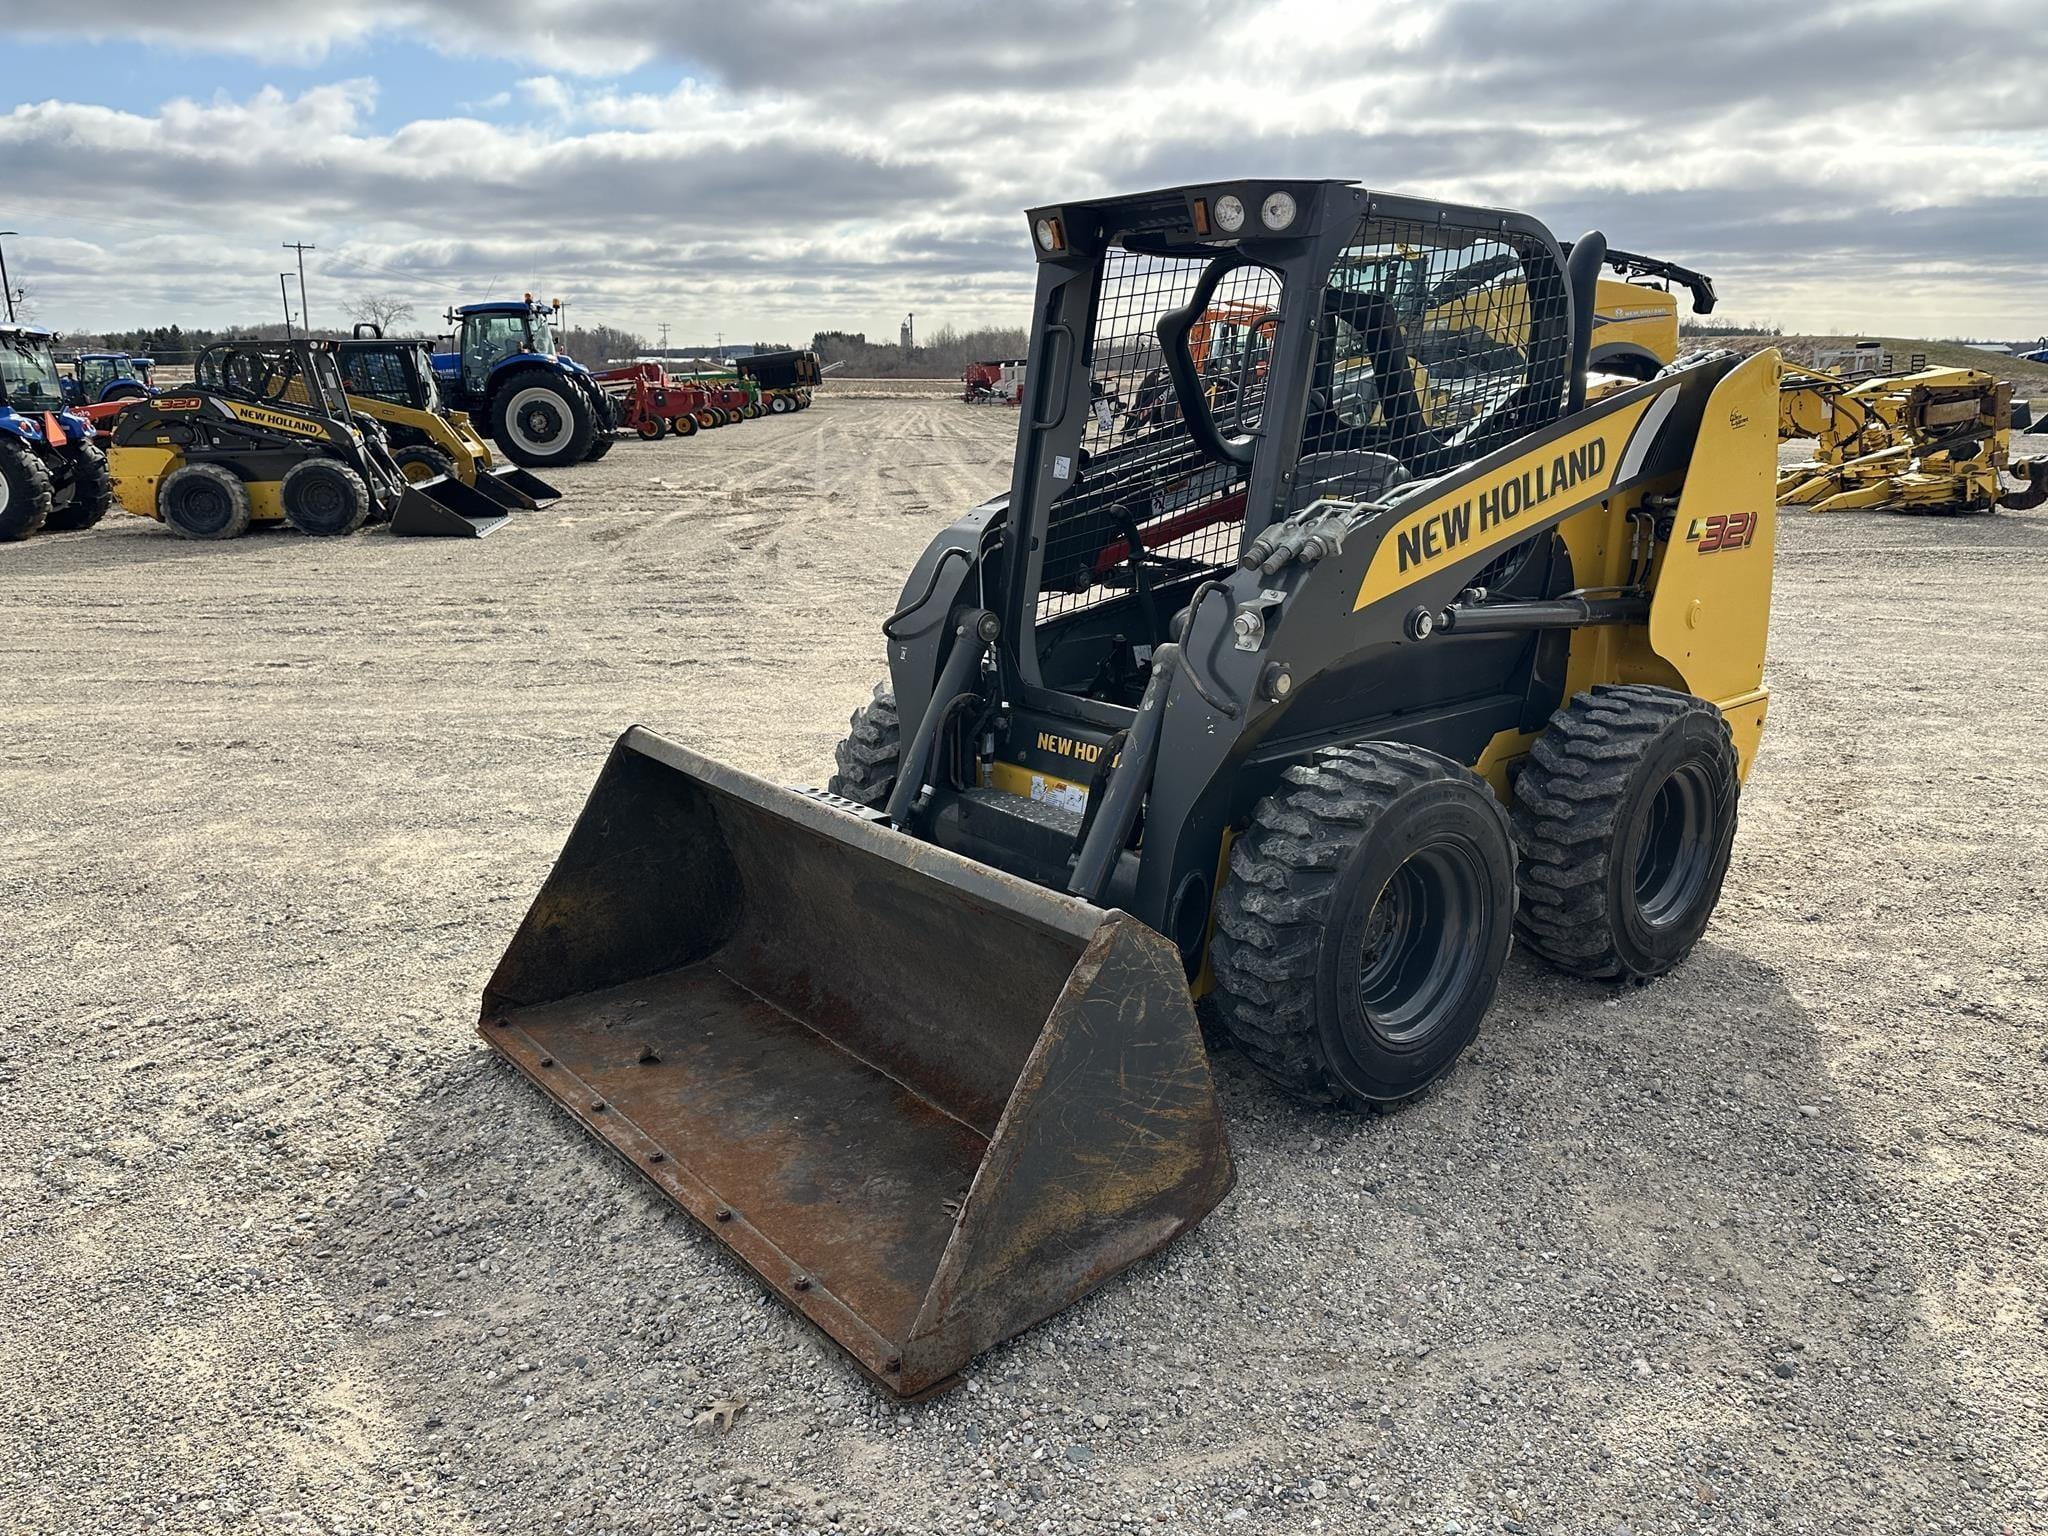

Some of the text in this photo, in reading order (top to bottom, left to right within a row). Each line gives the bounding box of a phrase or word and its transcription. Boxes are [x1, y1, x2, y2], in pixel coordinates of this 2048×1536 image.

[240, 407, 317, 434] NEW HOLLAND
[1397, 437, 1606, 575] NEW HOLLAND
[1686, 511, 1758, 554] L321
[1037, 732, 1073, 756] NEW
